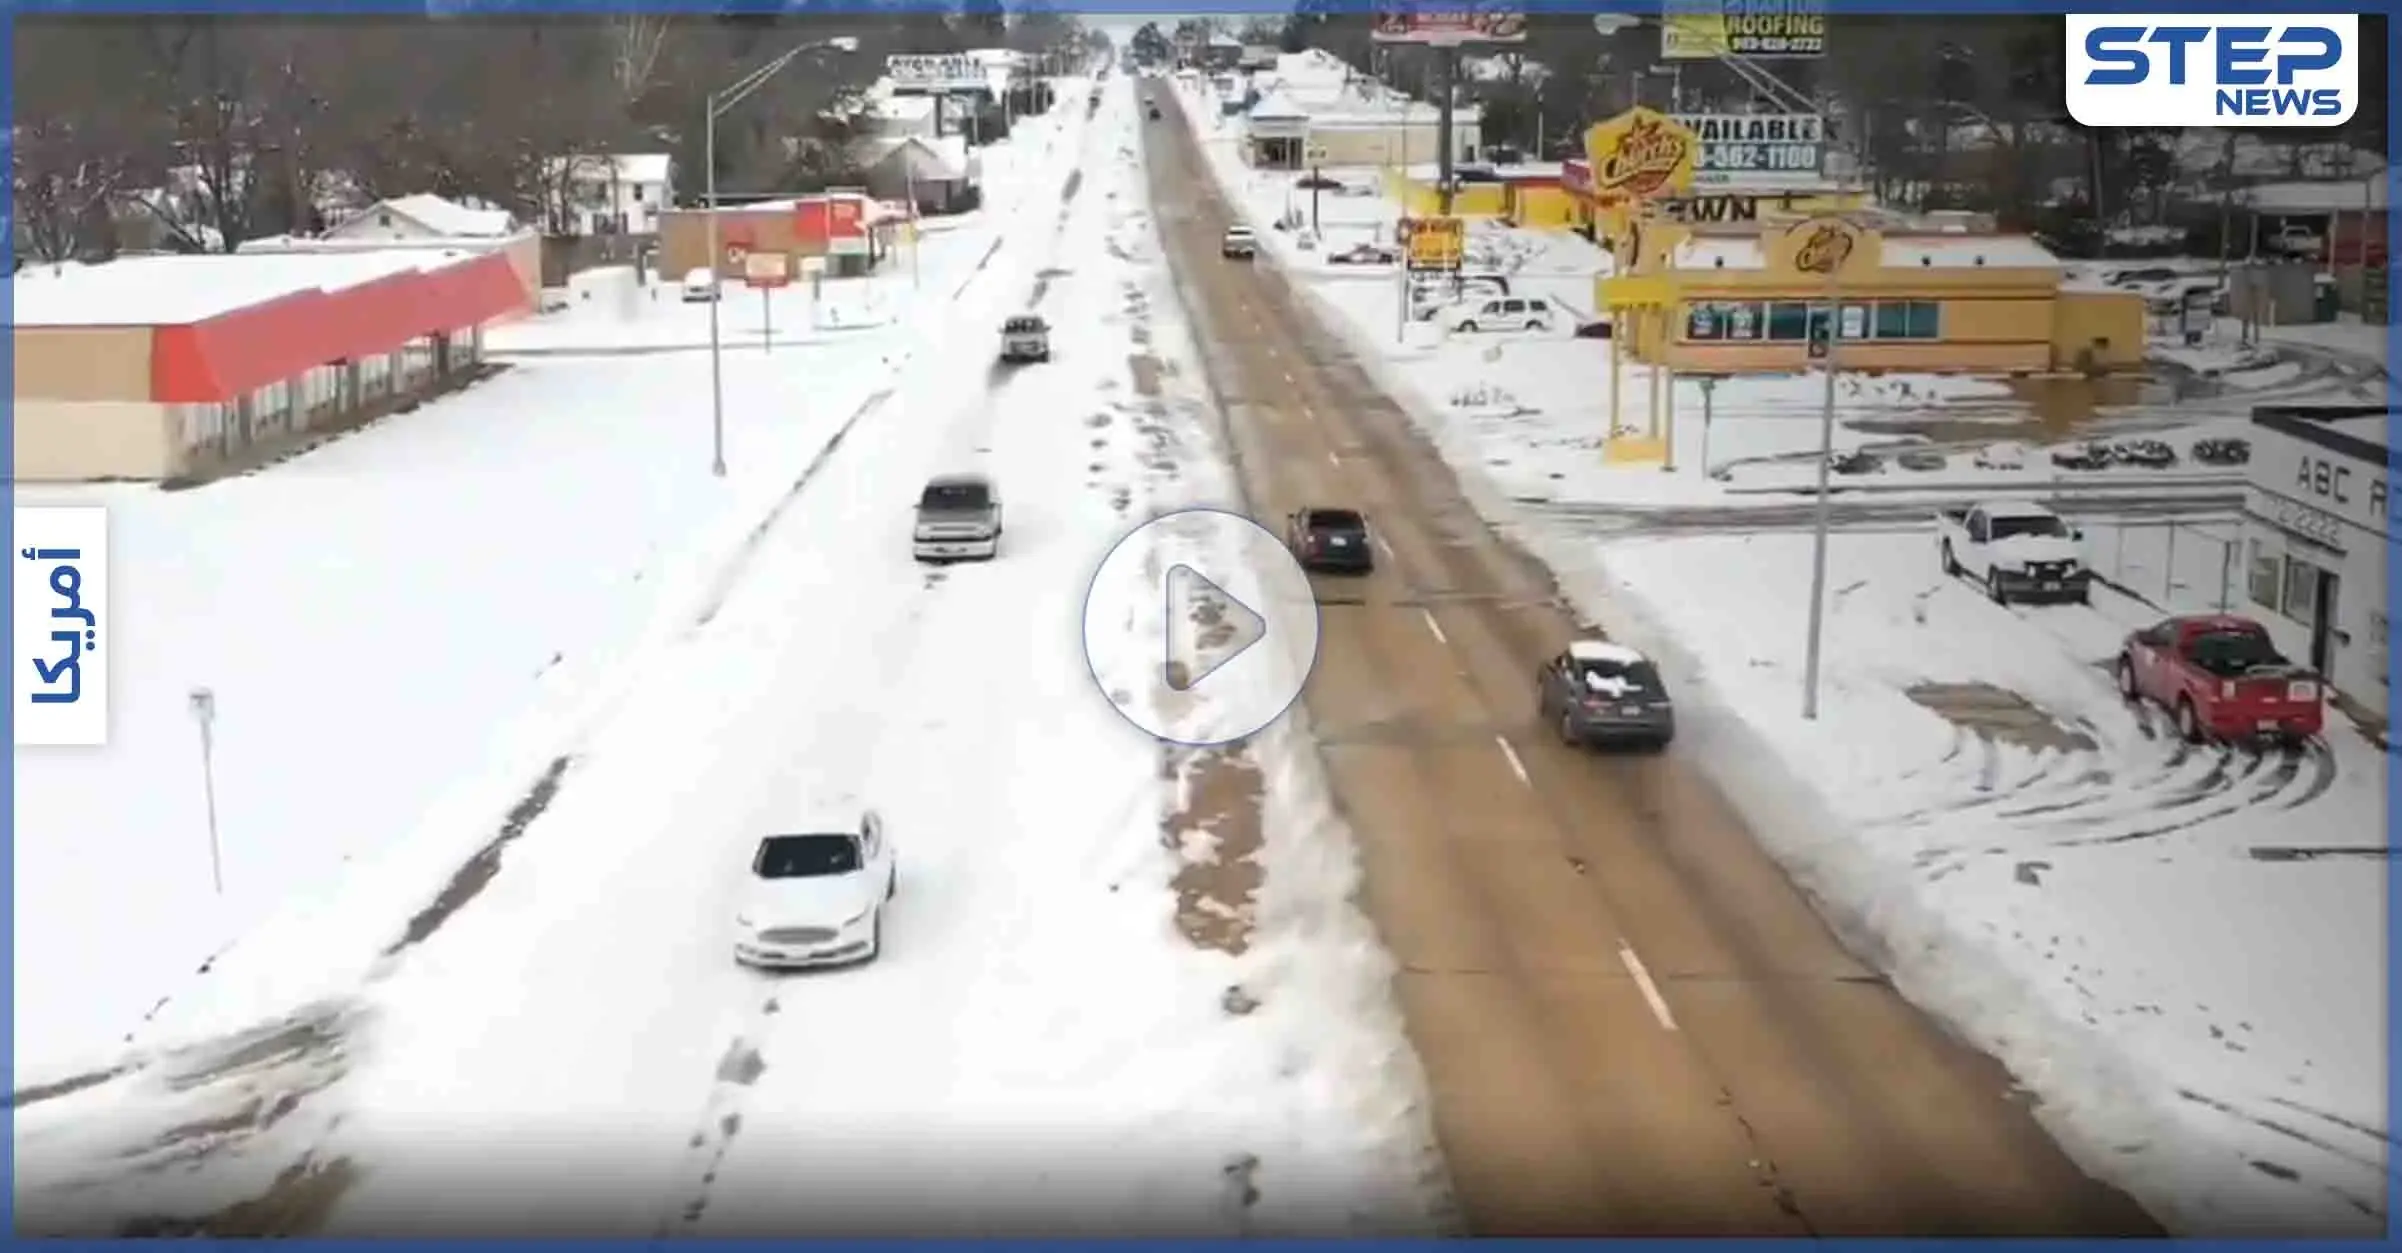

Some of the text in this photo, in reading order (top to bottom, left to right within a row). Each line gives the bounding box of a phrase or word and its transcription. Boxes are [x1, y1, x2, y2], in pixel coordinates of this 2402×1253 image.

[1727, 15, 1825, 35] ROOFING
[1674, 118, 1821, 141] VAILABLE
[2297, 455, 2351, 504] ABC
